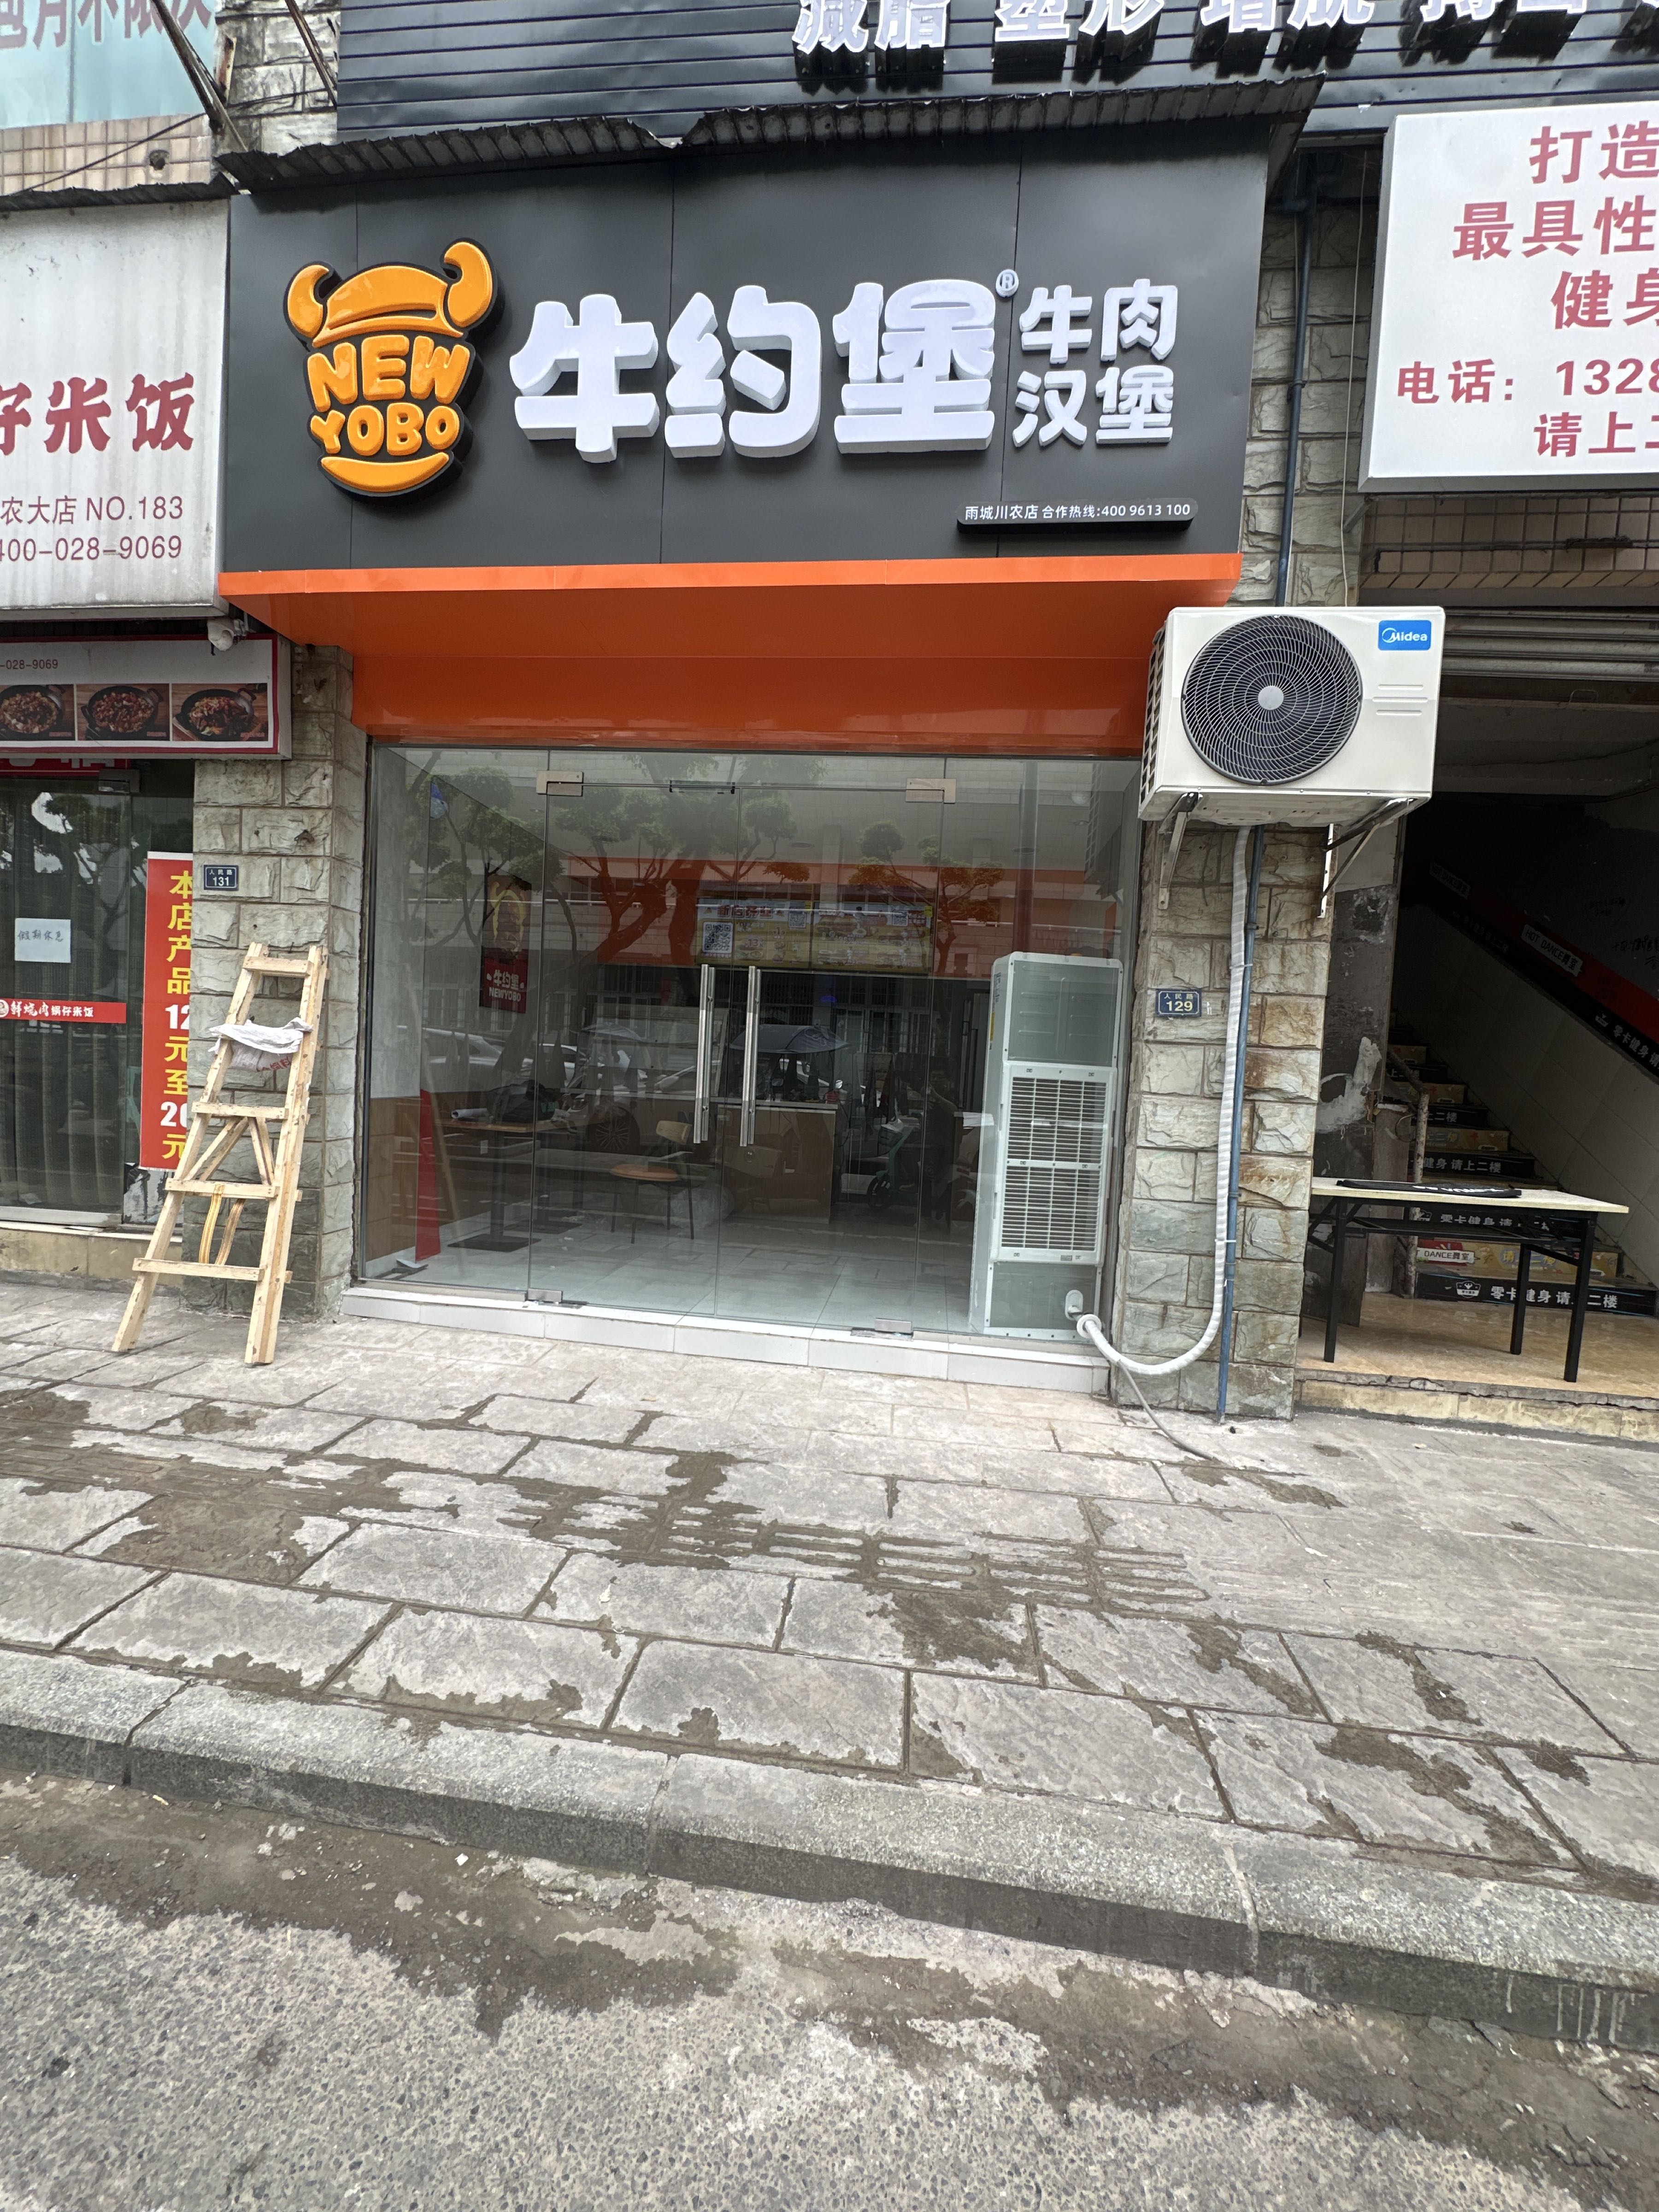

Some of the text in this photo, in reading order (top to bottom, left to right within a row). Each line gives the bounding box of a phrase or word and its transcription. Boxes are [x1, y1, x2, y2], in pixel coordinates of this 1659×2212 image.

[1529, 120, 1659, 184] 打造
[1453, 195, 1657, 261] 最具性
[1550, 267, 1659, 329] 健身
[1019, 278, 1178, 364] 牛肉
[307, 335, 470, 412] NEW
[510, 279, 996, 463] 牛约堡
[1012, 365, 1174, 447] 汉堡
[310, 402, 460, 456] YOBO
[965, 504, 1039, 520] 雨城川农店
[1129, 504, 1162, 516] 9613
[1166, 503, 1190, 516] 100
[0, 535, 182, 562] 00-028-9069
[1382, 627, 1428, 643] Midea
[213, 877, 229, 887] 131
[493, 969, 519, 990] 牛约堡
[489, 987, 522, 1002] NEWYOBO
[1166, 1001, 1193, 1012] 129
[1451, 1159, 1501, 1174] 请上二楼
[1503, 1250, 1556, 1266] 请二楼
[1556, 1291, 1619, 1309] 请二楼
